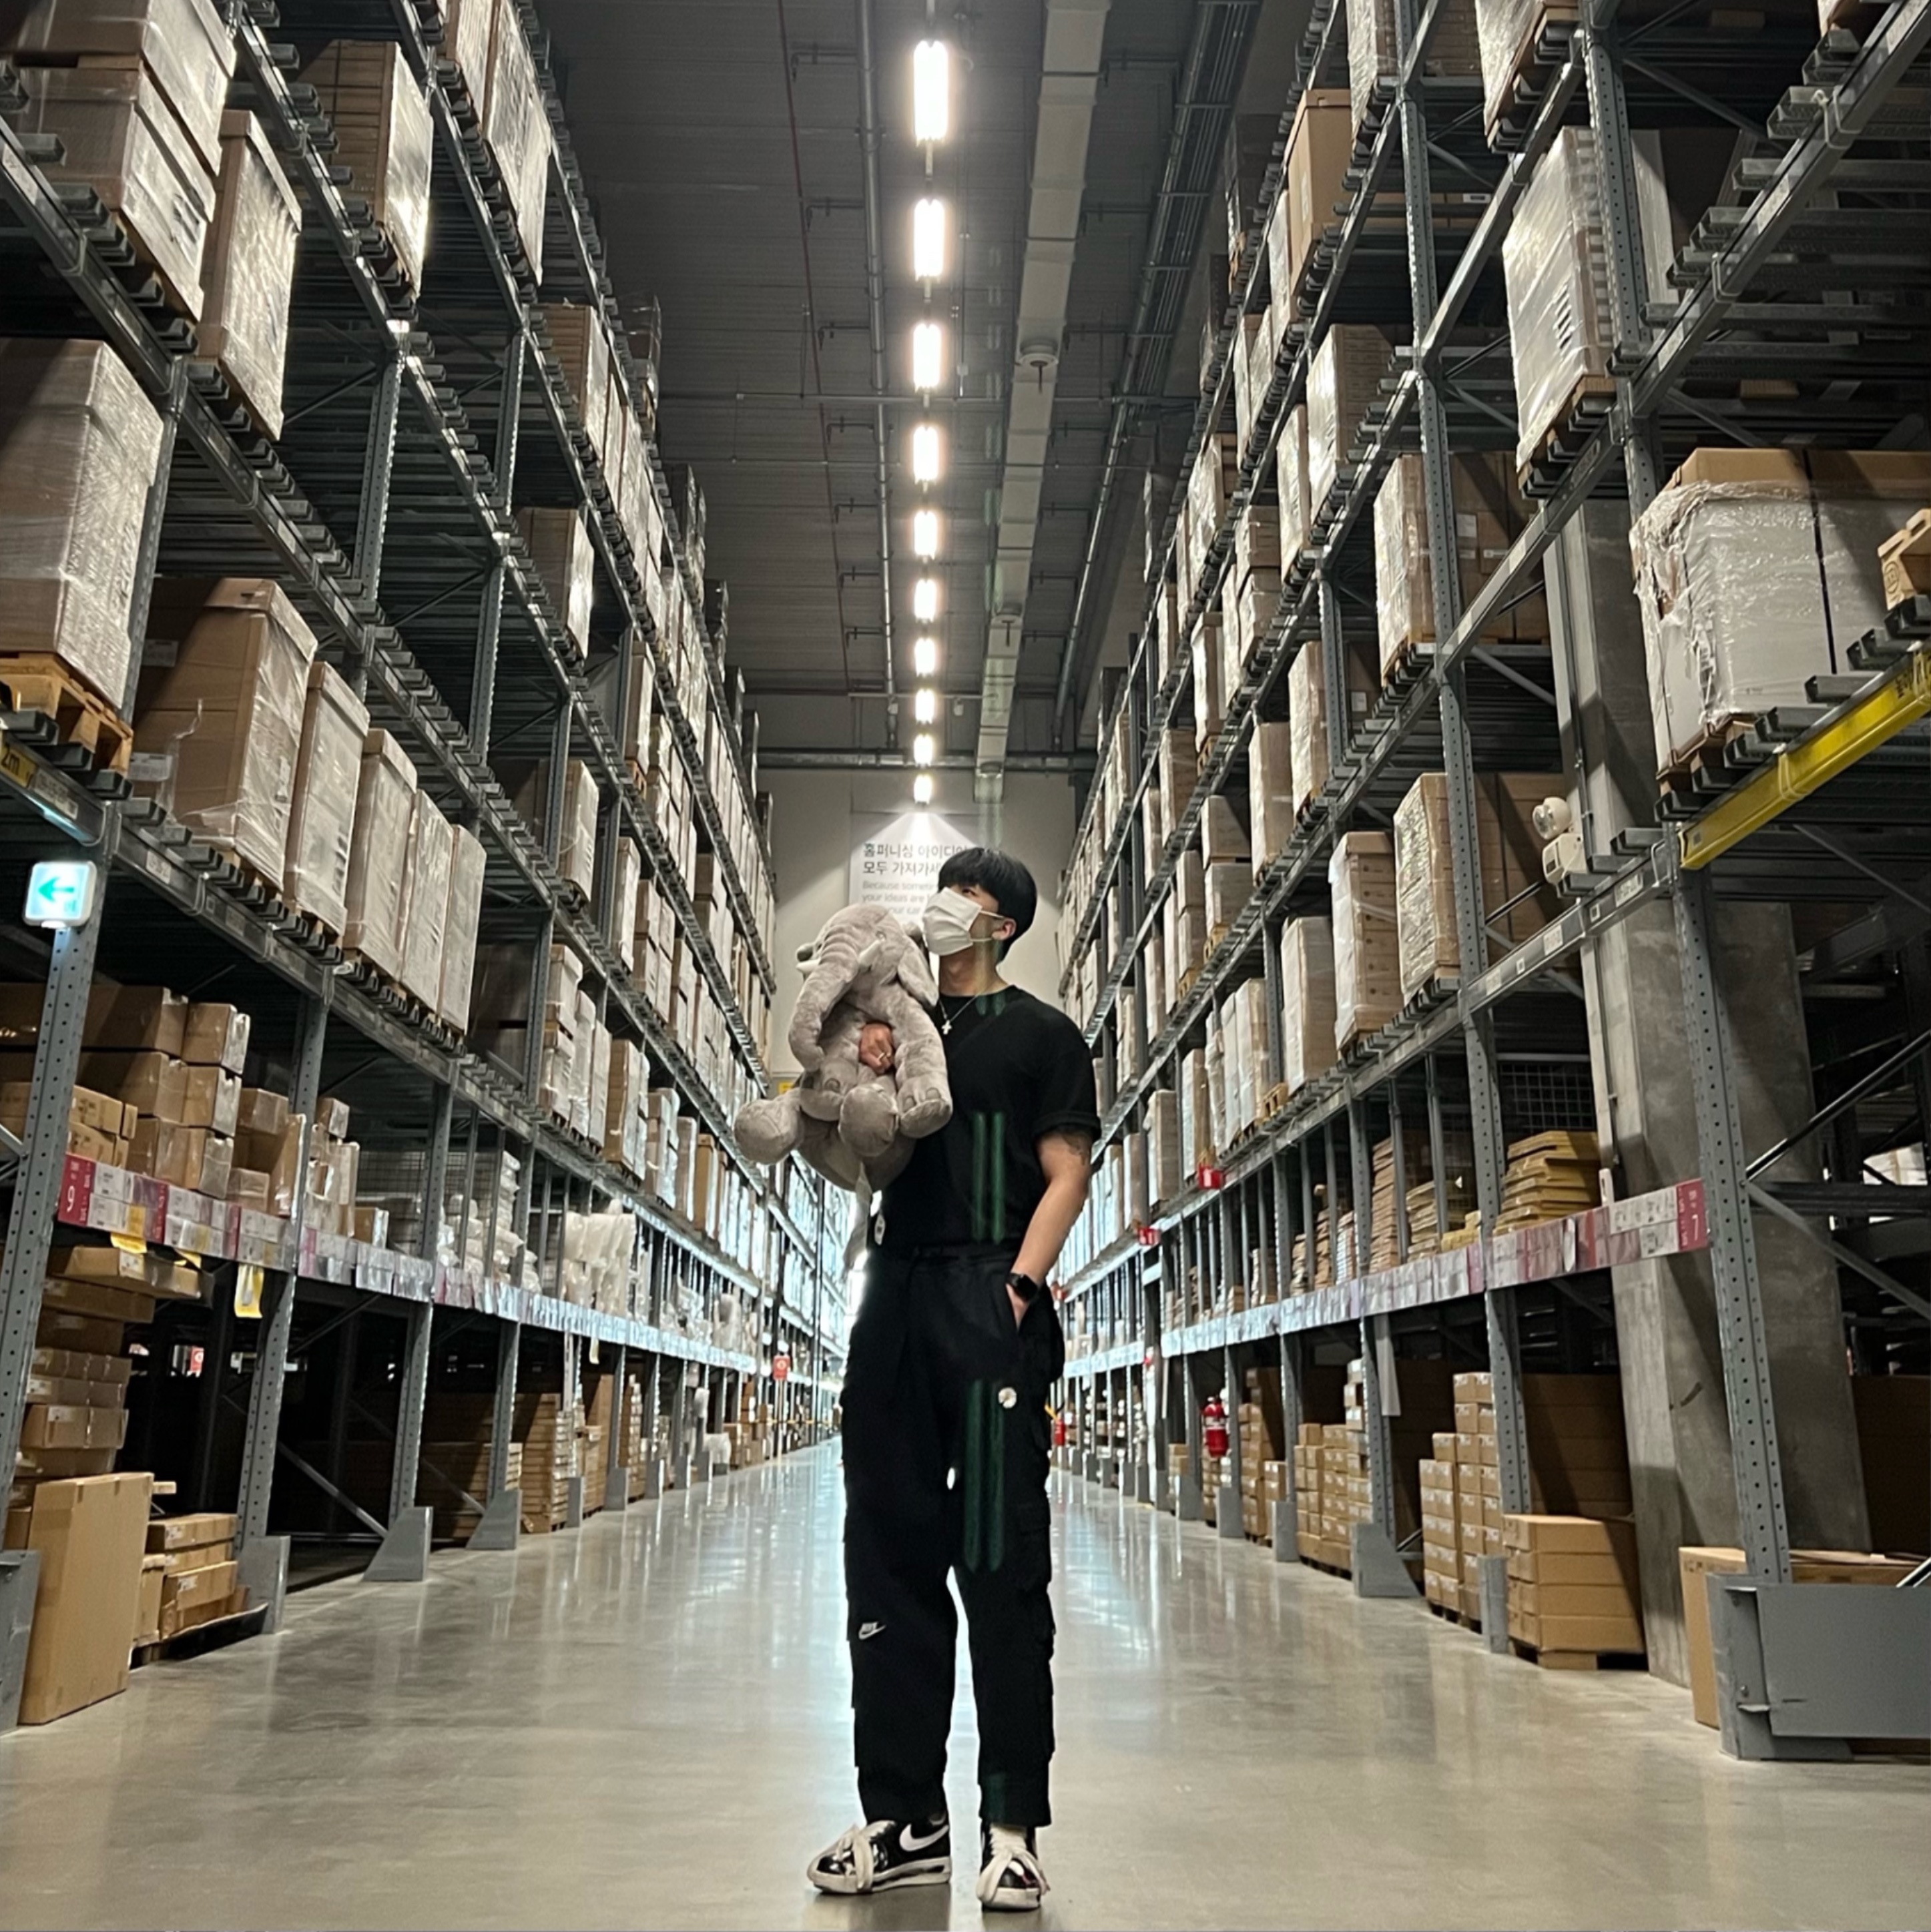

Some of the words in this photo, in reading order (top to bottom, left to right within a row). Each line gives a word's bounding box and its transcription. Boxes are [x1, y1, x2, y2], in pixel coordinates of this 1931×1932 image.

[864, 843, 913, 858] 홈퍼니싱
[863, 860, 887, 876] 모두
[862, 894, 882, 903] your
[67, 1185, 75, 1213] 9
[1691, 1213, 1699, 1241] 7
